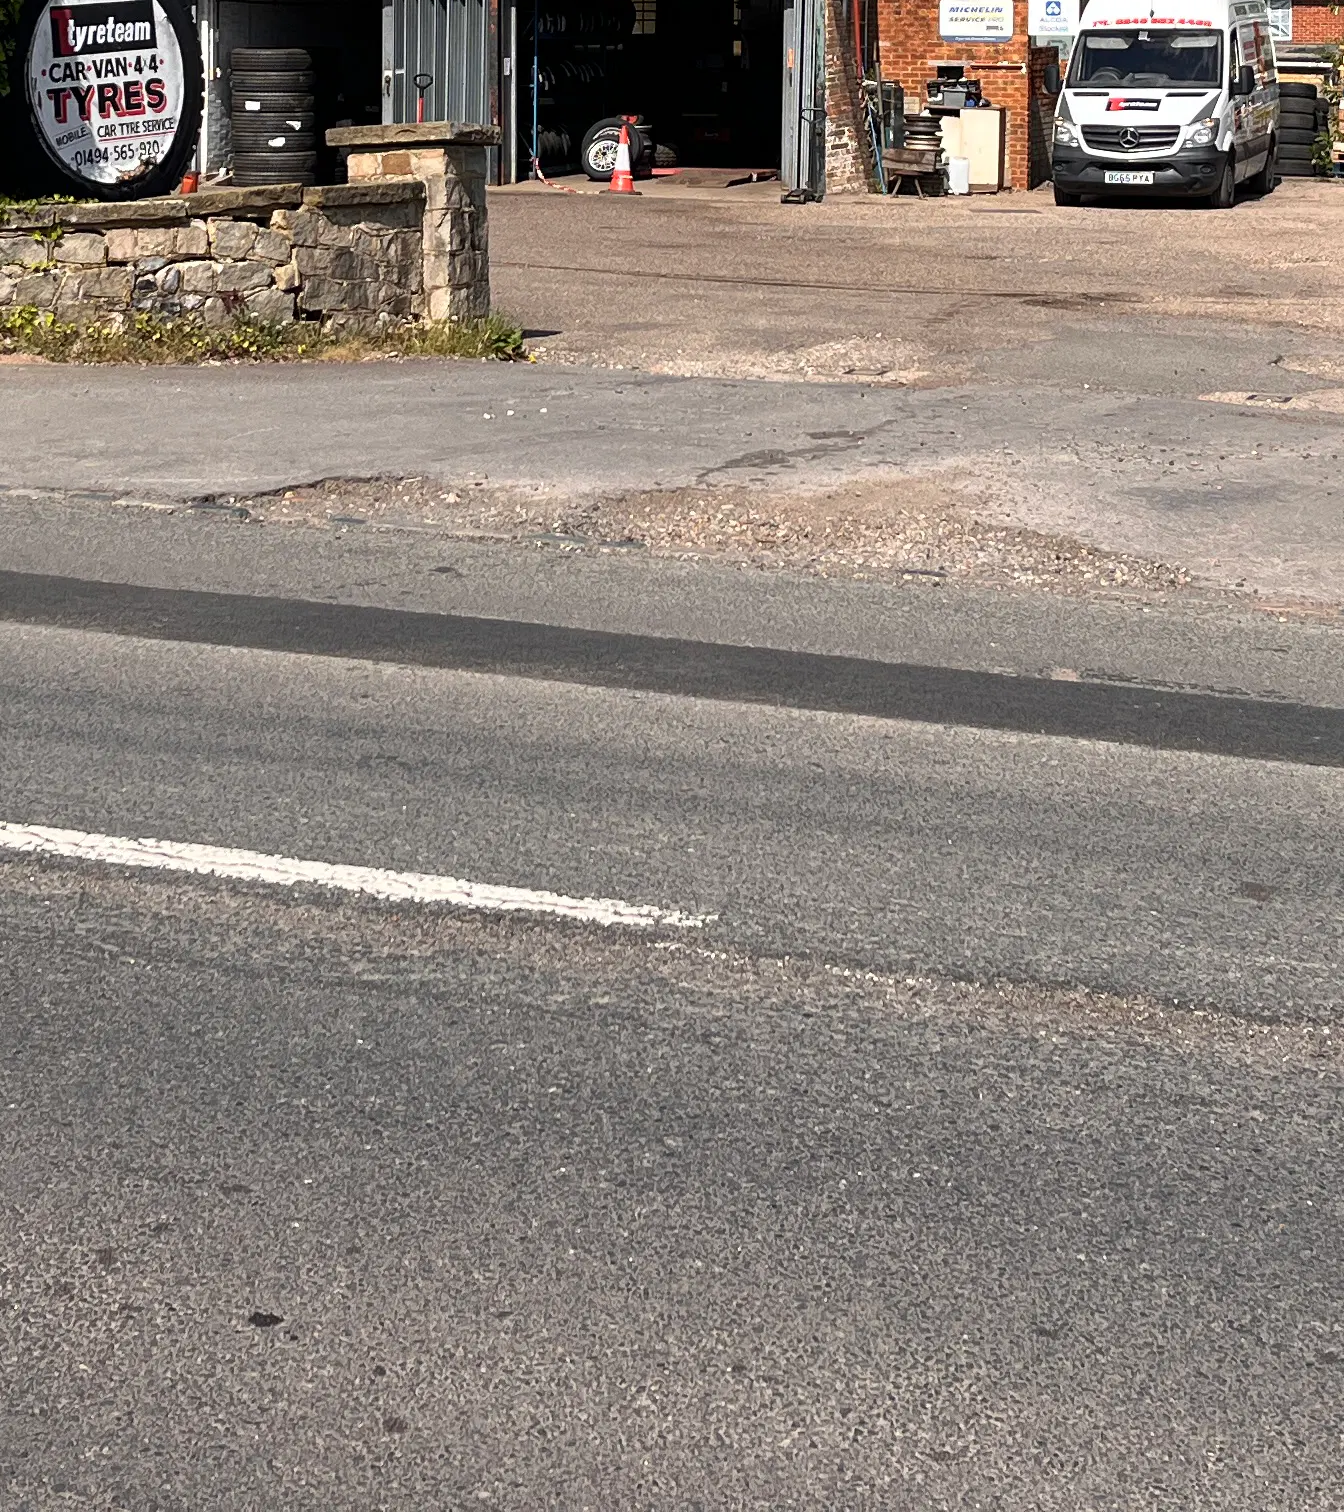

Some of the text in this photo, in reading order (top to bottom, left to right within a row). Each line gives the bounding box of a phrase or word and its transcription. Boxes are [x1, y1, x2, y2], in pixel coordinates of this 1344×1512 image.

[67, 16, 151, 52] tyreteam
[48, 62, 87, 84] CAR
[91, 56, 128, 80] VAN
[45, 77, 168, 124] TYRES
[97, 117, 176, 138] CAR TYRE SERVICE
[74, 147, 109, 167] 01494
[113, 143, 135, 161] 565
